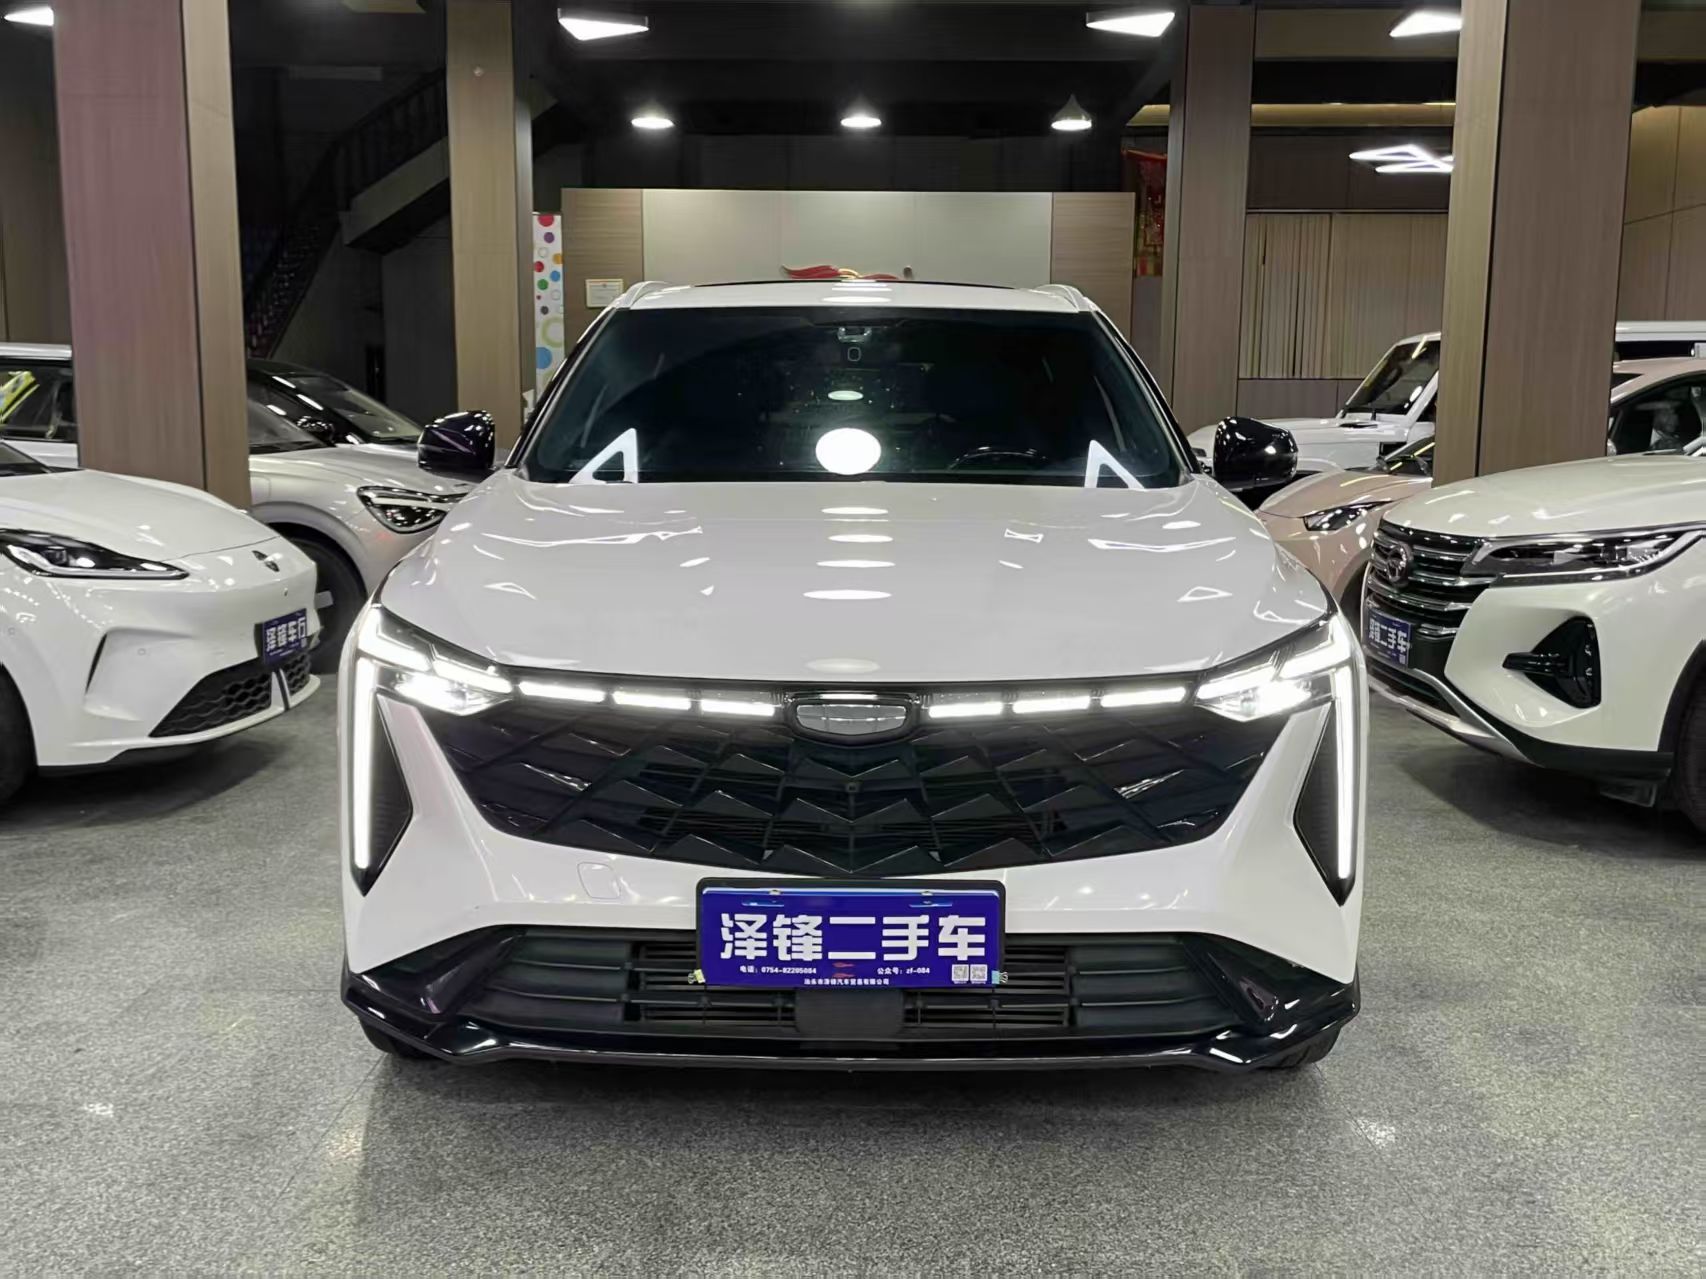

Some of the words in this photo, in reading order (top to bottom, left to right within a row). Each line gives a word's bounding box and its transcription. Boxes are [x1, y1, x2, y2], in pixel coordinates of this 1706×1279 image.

[1368, 618, 1407, 653] 泽锋二手车
[720, 912, 986, 961] 泽锋二手车
